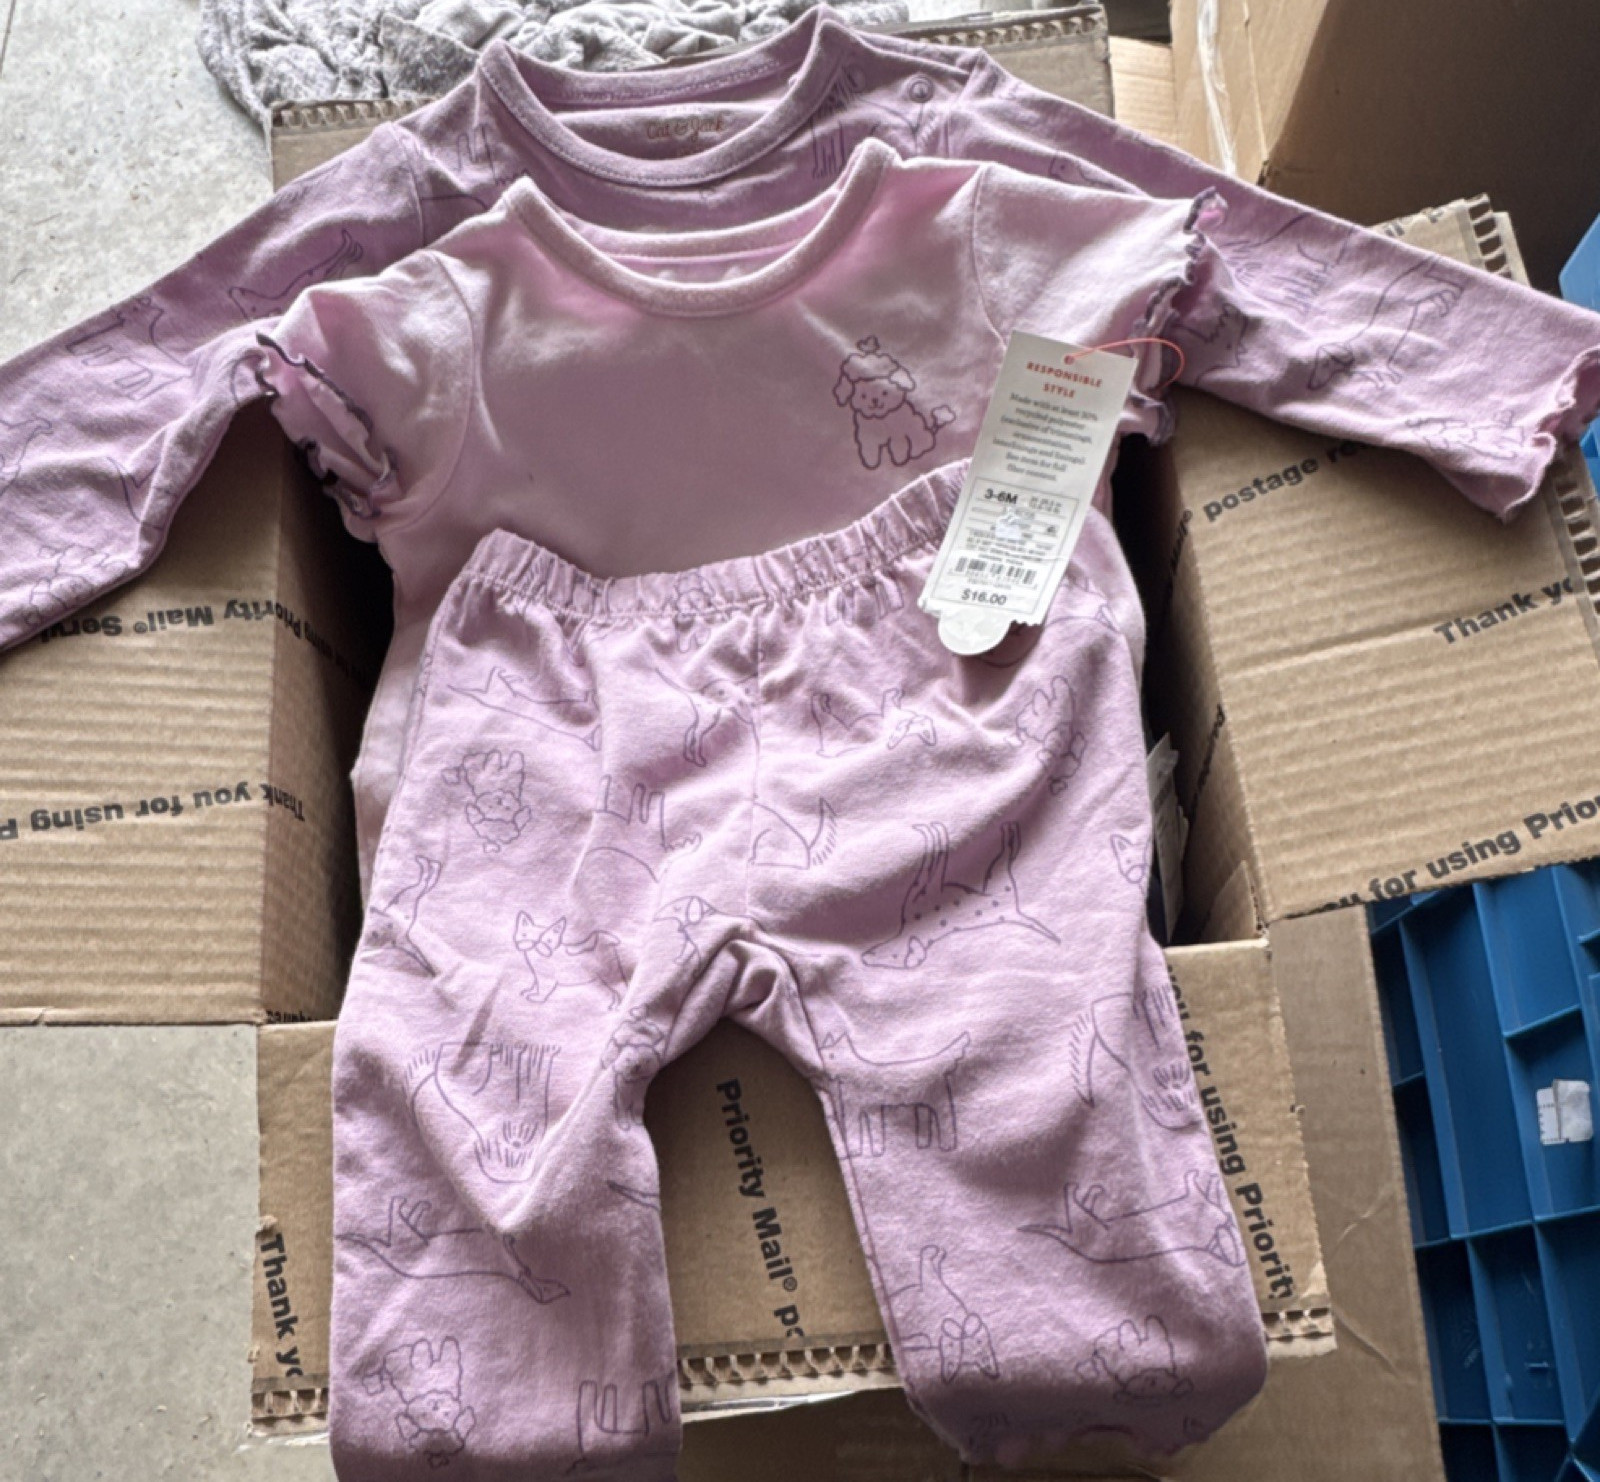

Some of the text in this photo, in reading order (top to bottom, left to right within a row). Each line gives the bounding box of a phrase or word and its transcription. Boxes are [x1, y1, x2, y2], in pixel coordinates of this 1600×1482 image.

[1026, 361, 1103, 388] RESPONSIBLE
[1043, 383, 1077, 399] STYLE
[984, 487, 1018, 505] 3-6M
[1203, 455, 1319, 523] postage
[961, 589, 1007, 606] $16.00
[224, 599, 302, 639] Priority
[1433, 592, 1539, 644] Thank
[135, 795, 184, 817] for
[193, 781, 252, 809] you
[260, 783, 305, 822] Thank
[30, 803, 124, 832] using
[1368, 870, 1418, 902] for
[1425, 829, 1521, 879] using
[1184, 1030, 1211, 1076] for
[1202, 1087, 1245, 1176] using
[717, 1079, 765, 1198] Priority
[260, 1233, 298, 1340] Thank
